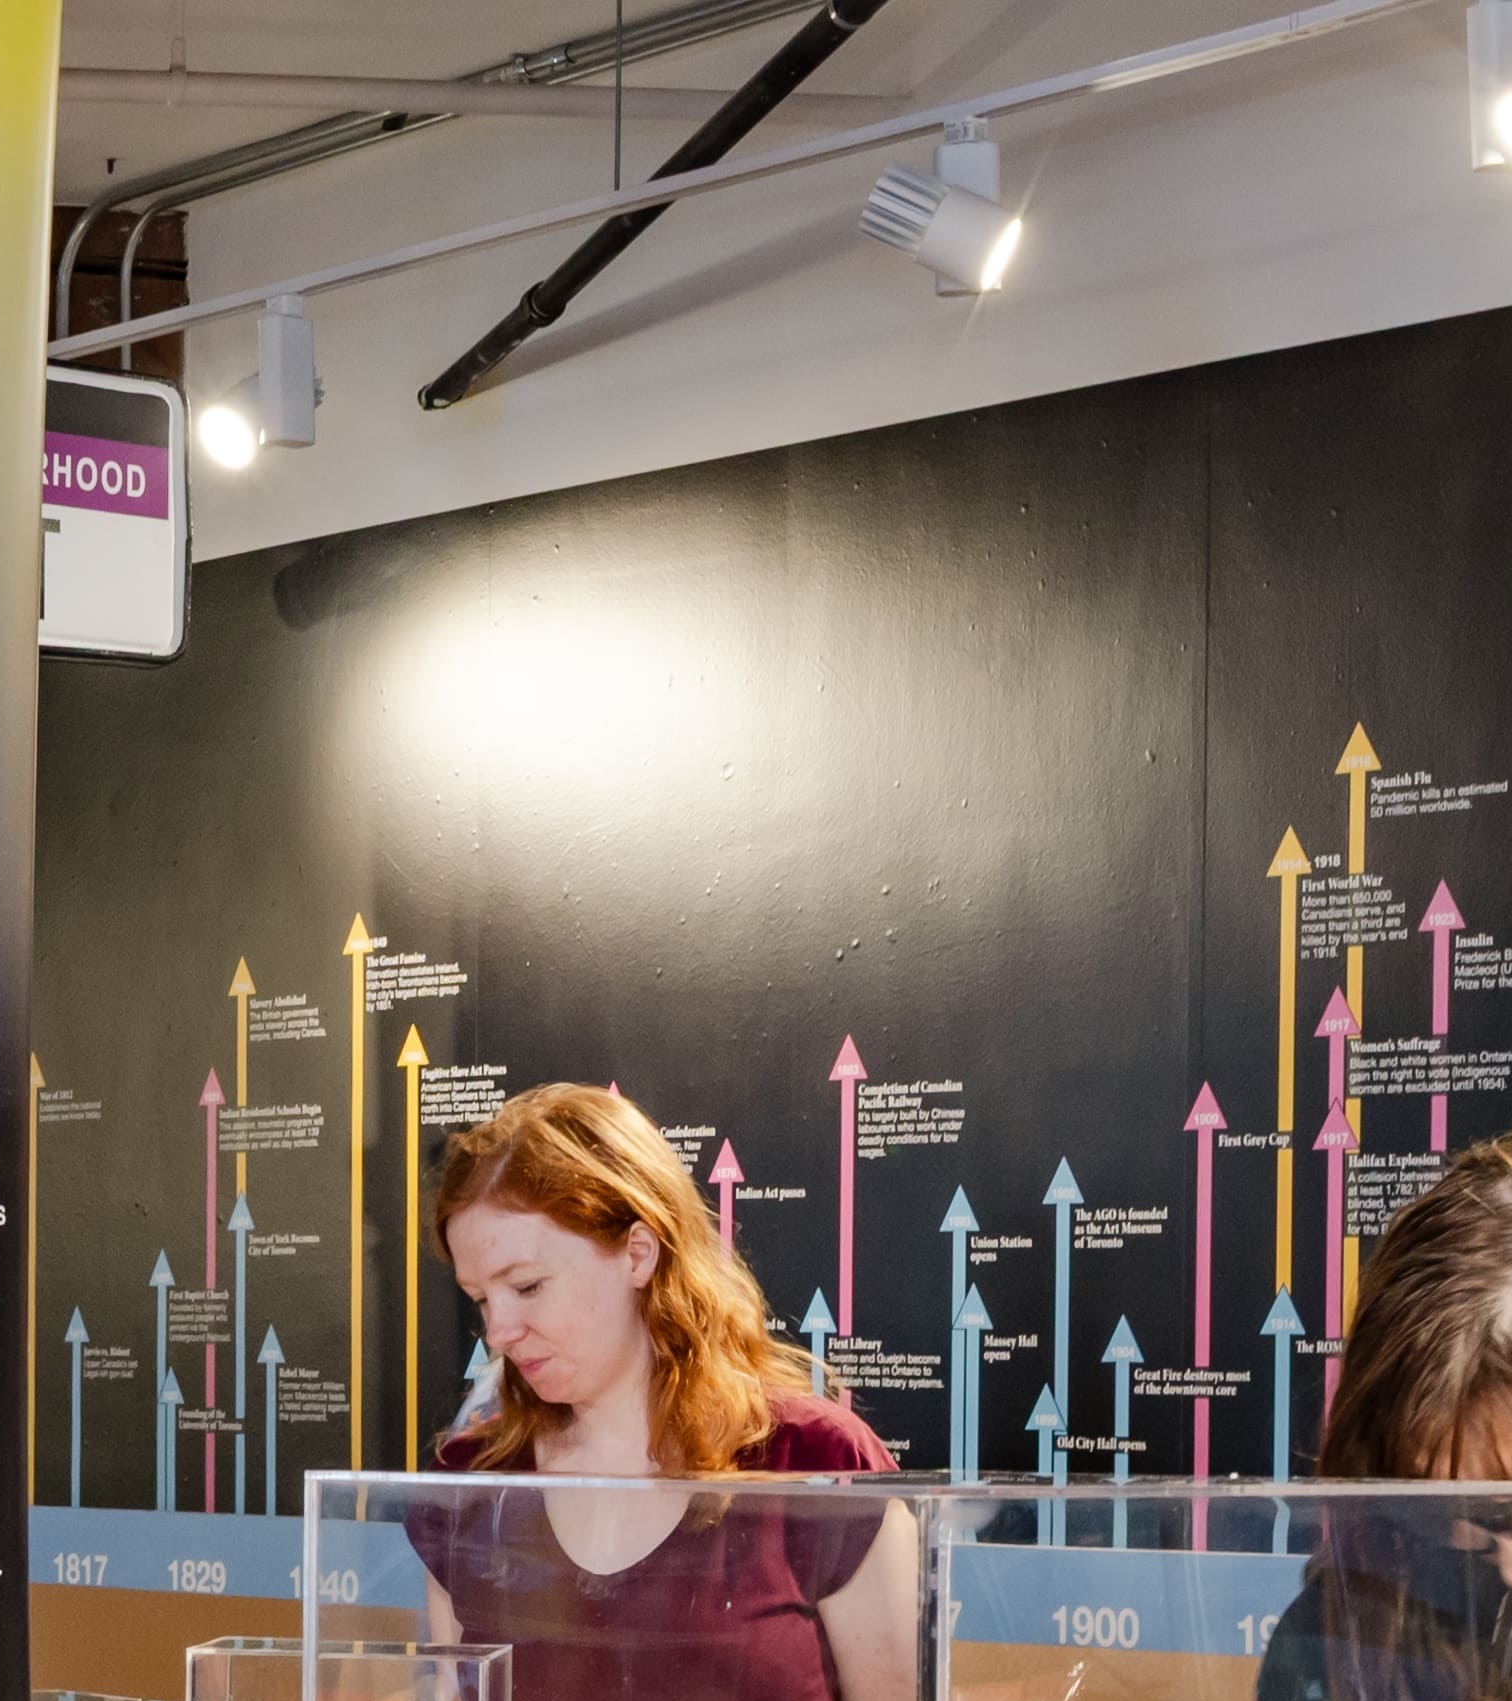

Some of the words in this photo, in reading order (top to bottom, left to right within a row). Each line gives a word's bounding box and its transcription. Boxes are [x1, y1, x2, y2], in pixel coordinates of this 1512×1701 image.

[1371, 773, 1411, 789] Spanish
[1414, 771, 1431, 784] Flu
[1350, 1039, 1395, 1053] Women's
[1397, 1037, 1440, 1052] Suffrage
[858, 1082, 909, 1096] Completion
[910, 1081, 920, 1094] of
[920, 1078, 963, 1092] Canadian
[858, 1094, 887, 1109] Pacific
[888, 1095, 923, 1110] Railway
[1219, 1134, 1241, 1146] First
[1243, 1134, 1267, 1148] Grey
[1269, 1134, 1289, 1147] Cup
[1075, 1208, 1093, 1221] The
[1094, 1208, 1117, 1221] AGO
[1118, 1208, 1127, 1220] is
[1128, 1206, 1168, 1219] founded
[1074, 1225, 1085, 1235] as
[1086, 1222, 1102, 1234] the
[1103, 1222, 1119, 1234] Art
[1121, 1221, 1162, 1234] Museum
[1074, 1236, 1084, 1249] of
[1086, 1236, 1124, 1248] Toronto
[1134, 1368, 1161, 1381] Great
[1162, 1368, 1183, 1381] Fire
[1183, 1368, 1224, 1384] destroys
[1225, 1371, 1251, 1382] most
[54, 1553, 107, 1585] 1817
[168, 1560, 226, 1593] 1829
[289, 1565, 359, 1604] 140
[1052, 1605, 1139, 1648] 1900
